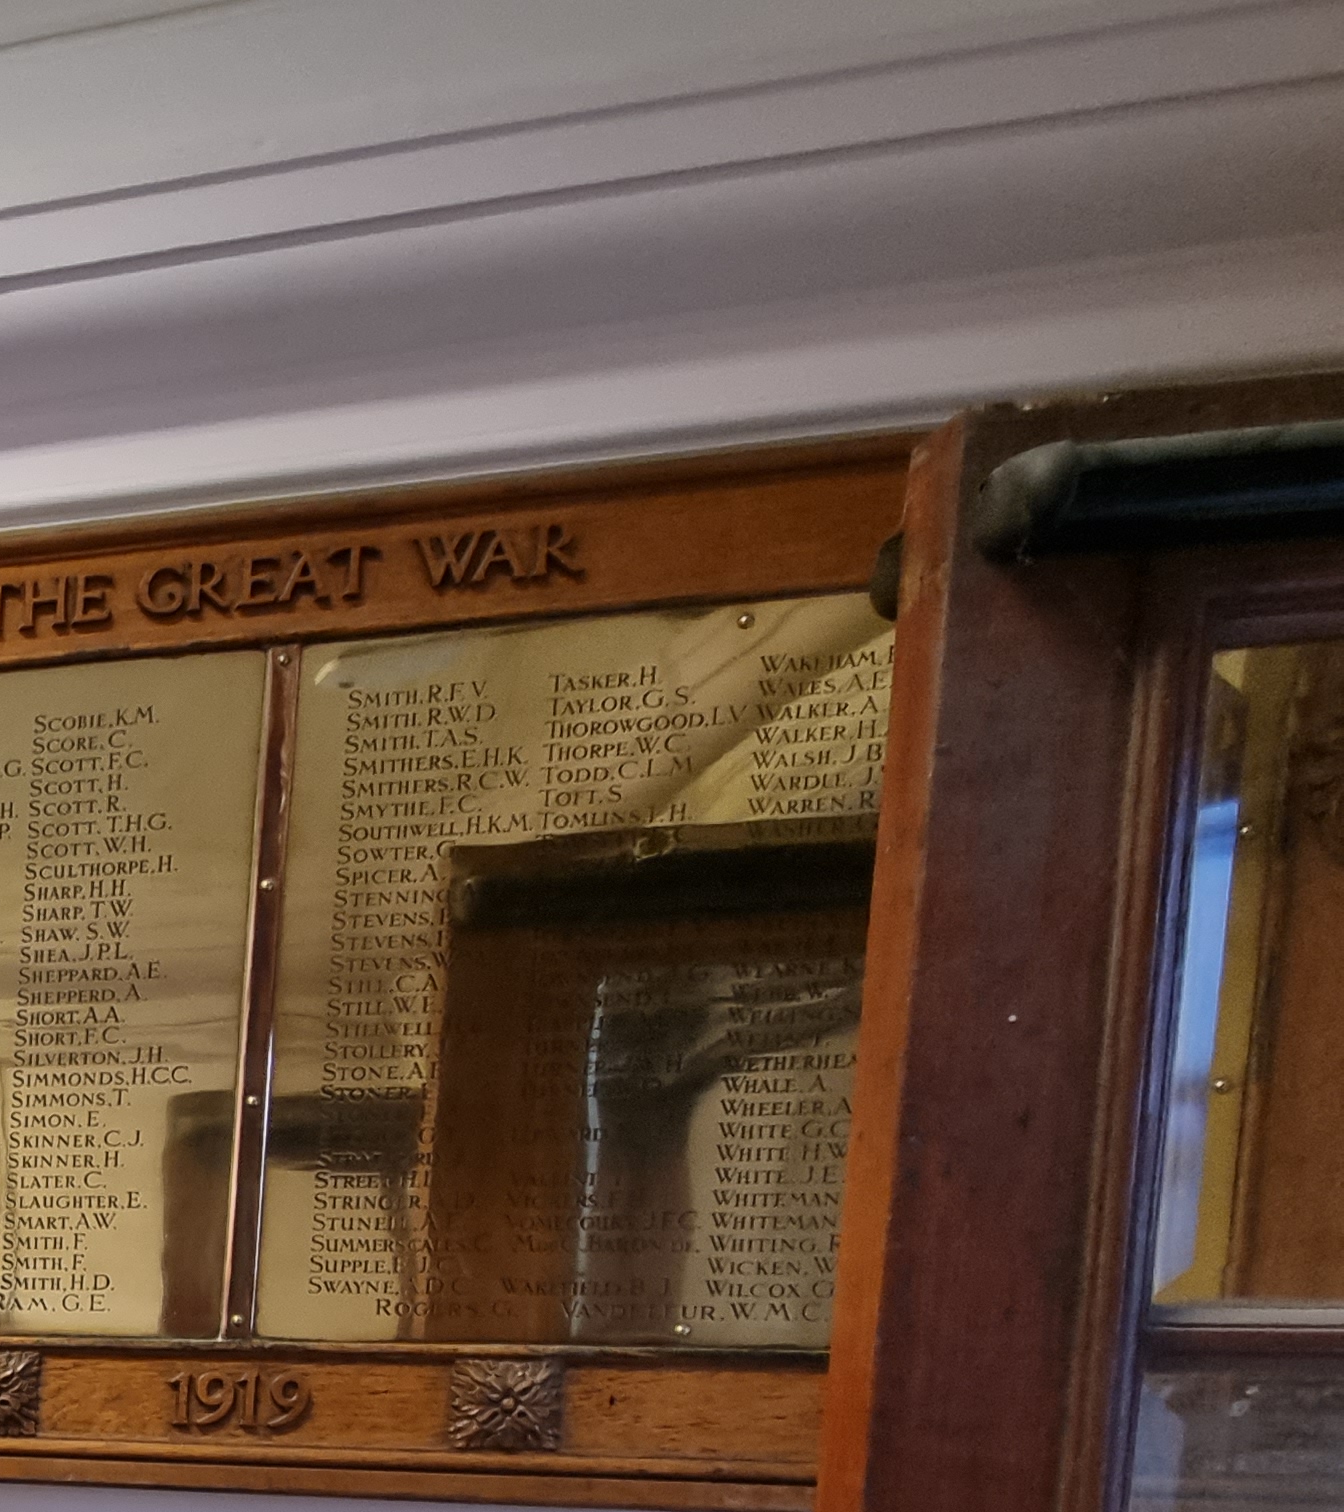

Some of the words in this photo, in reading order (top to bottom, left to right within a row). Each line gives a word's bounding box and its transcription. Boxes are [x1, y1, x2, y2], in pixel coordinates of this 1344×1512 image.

[136, 544, 383, 622] GREAT
[412, 523, 586, 589] WAR
[166, 1370, 313, 1435] 1919
